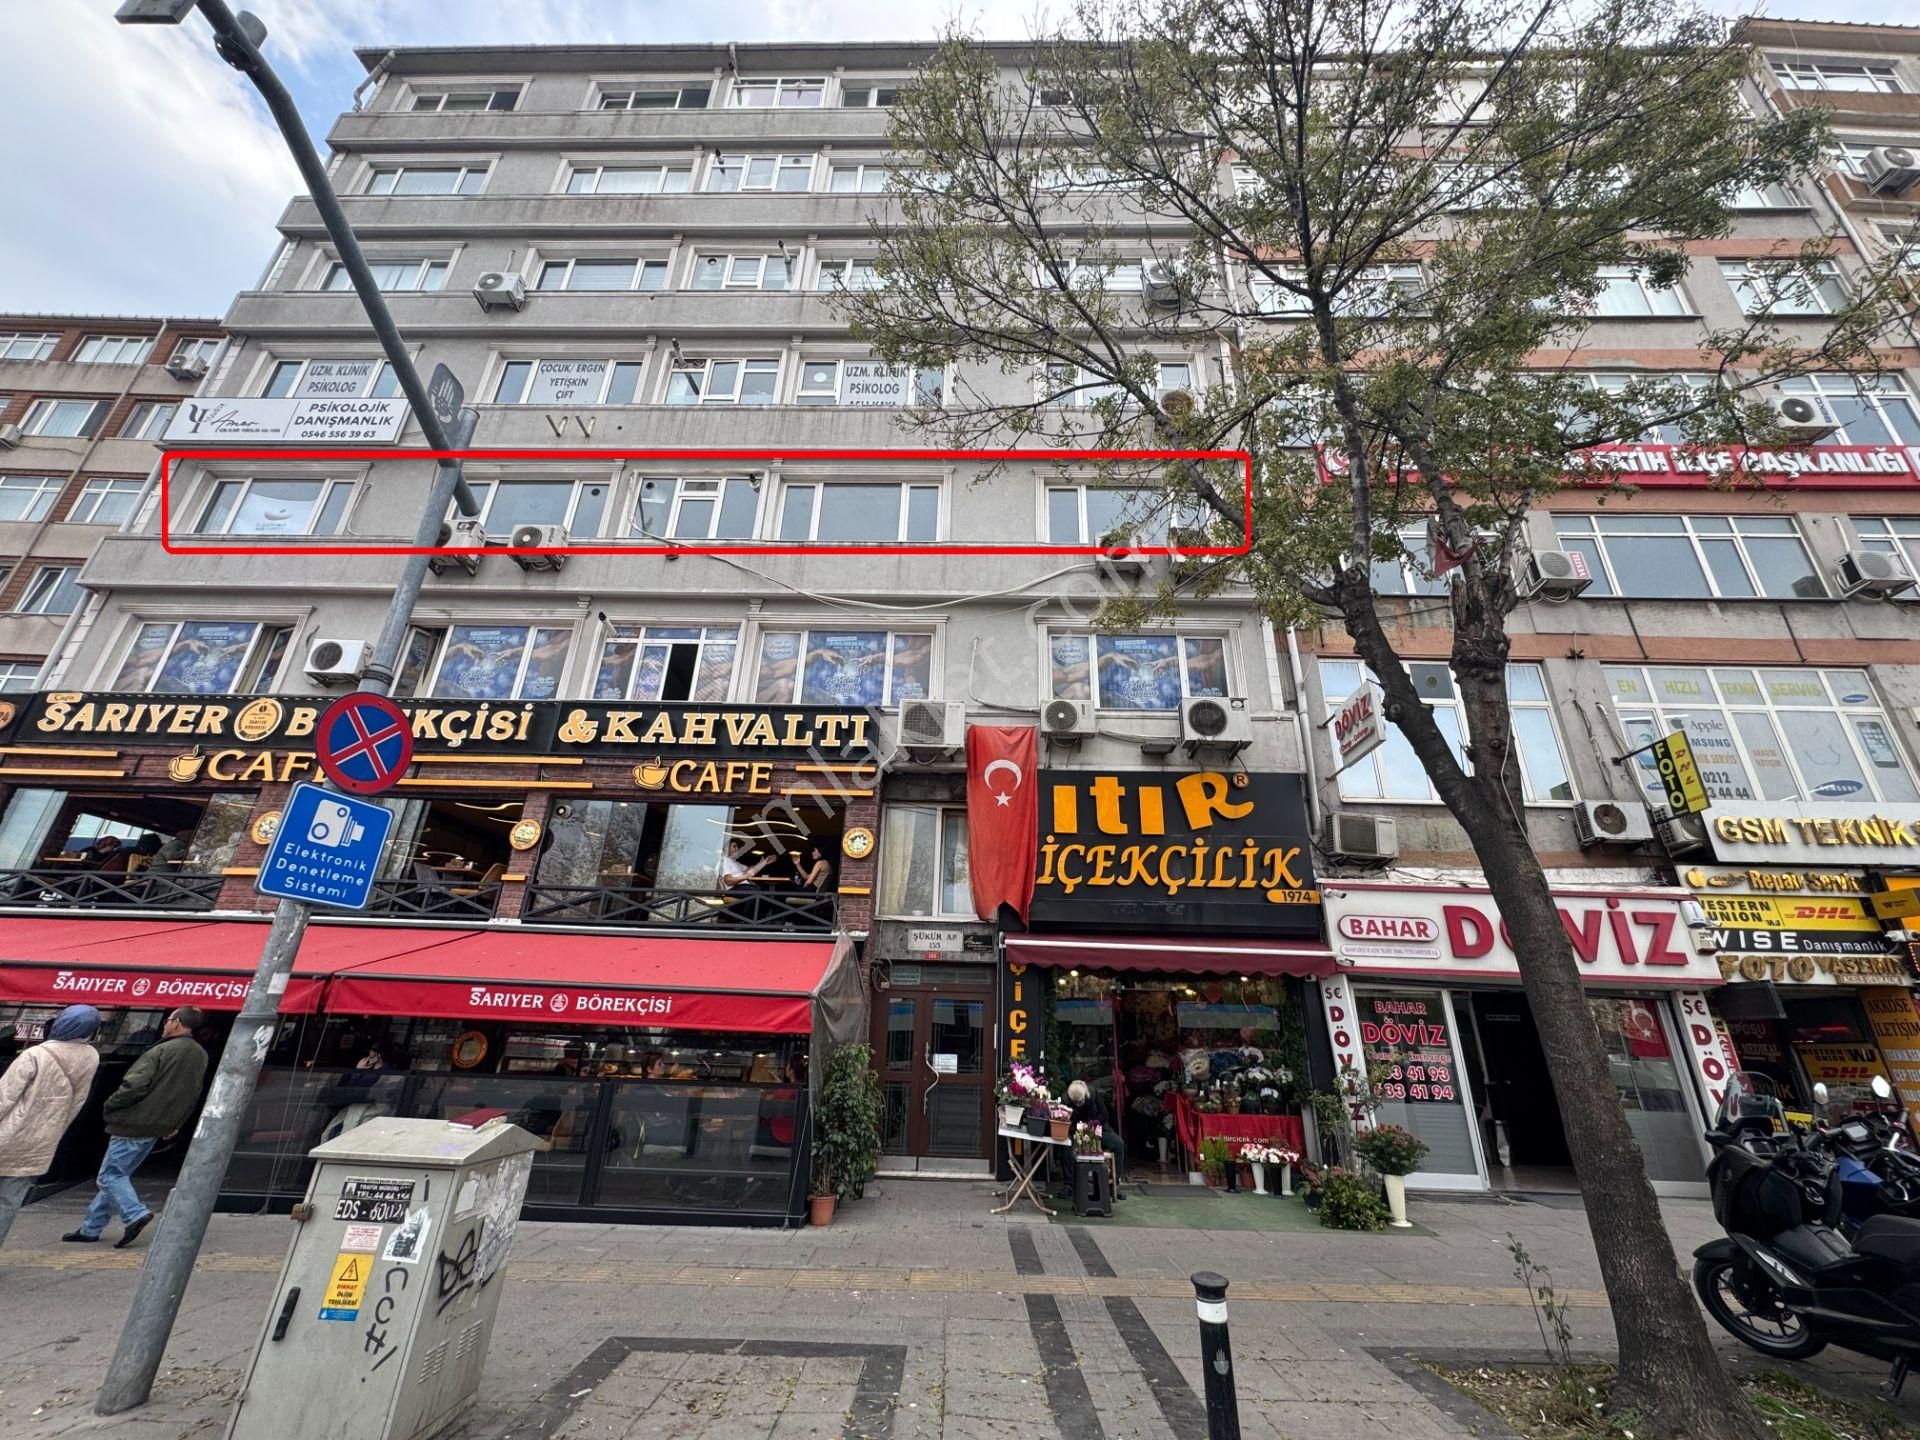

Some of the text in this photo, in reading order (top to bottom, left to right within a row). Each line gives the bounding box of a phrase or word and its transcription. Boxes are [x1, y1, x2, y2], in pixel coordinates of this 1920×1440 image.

[310, 362, 370, 377] UZM. KLİNİK
[576, 363, 606, 373] ERGEN
[846, 366, 871, 378] UZM.
[308, 378, 357, 393] PSİKOLOG
[550, 376, 589, 389] YETİŞKİN
[849, 380, 900, 395] PSİKOLOG
[555, 388, 575, 402] ÇİFT
[309, 401, 391, 413] PSİKOLOJİK
[294, 415, 394, 429] DANIŞMANLIK
[301, 430, 376, 438] 0546 556 39 63
[1739, 447, 1910, 480] BAŞKANLIĞI
[1617, 680, 1637, 693] EN
[1719, 680, 1758, 696] TEKNİK
[1770, 680, 1822, 697] SERVİS
[37, 702, 871, 747] SARIYER BKÇİSİ & KAHVALTI
[1335, 695, 1373, 740] DÖVİZ
[1690, 720, 1724, 733] Apple
[1691, 738, 1731, 747] MSUNG
[207, 749, 774, 793] CAF CAFE
[1654, 742, 1686, 808] FOTO
[1674, 749, 1695, 785] DHL
[1702, 772, 1731, 783] 0212
[1718, 787, 1733, 799] 44
[1735, 787, 1750, 800] 44
[1716, 815, 1792, 844] GSM
[1788, 813, 1917, 846] TEKNİK
[284, 842, 368, 872] Elektronik
[1035, 834, 1304, 896] İÇEKÇİLİK
[275, 857, 365, 886] Denetleme
[1750, 869, 1803, 891] Repair
[284, 876, 348, 898] Sistemi
[1281, 890, 1312, 902] 1974
[1707, 911, 1763, 922] UNION
[1793, 906, 1858, 920] DHL
[913, 931, 942, 942] ŞÜKÜR
[1349, 897, 1690, 966] BAHAR DVİZ
[1710, 930, 1888, 953] WISE Danışmanlık
[1715, 955, 1815, 982] FOTO
[53, 976, 250, 1000] SARIYER BÖREKÇİSİ
[469, 992, 673, 1016] SARIYER BÖREKÇİSİ
[1374, 1000, 1427, 1015] BAHAR
[1361, 1018, 1447, 1046] DÖVİZ
[1690, 1024, 1729, 1105] DÖV
[1819, 1066, 1874, 1079] DHL
[1407, 1065, 1425, 1081] 41
[1427, 1066, 1450, 1082] 93
[1409, 1083, 1428, 1099] 41
[1431, 1084, 1454, 1100] 94
[333, 1199, 361, 1220] EDS
